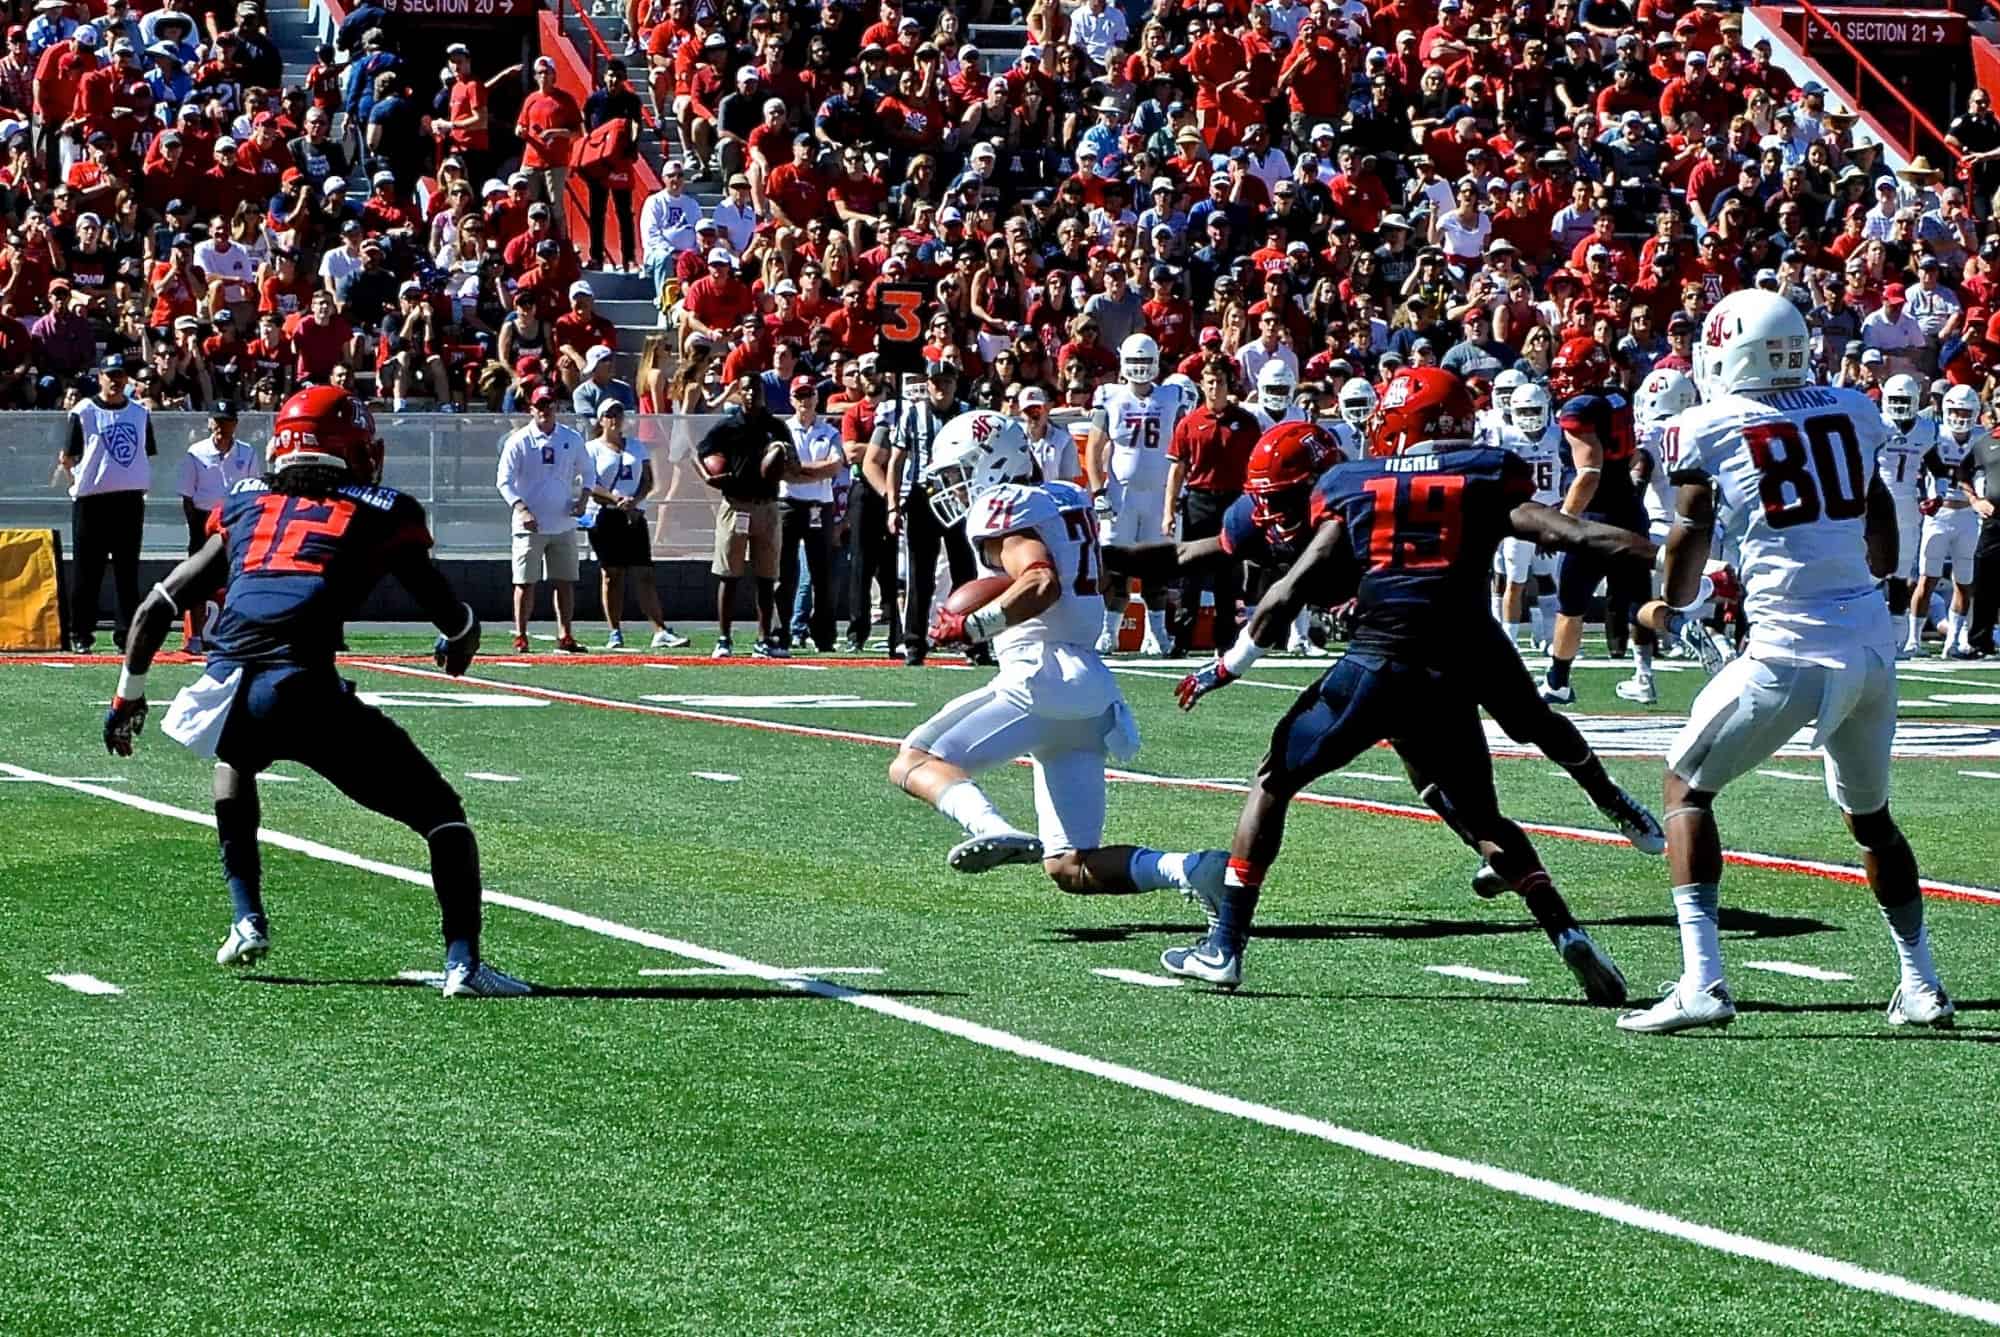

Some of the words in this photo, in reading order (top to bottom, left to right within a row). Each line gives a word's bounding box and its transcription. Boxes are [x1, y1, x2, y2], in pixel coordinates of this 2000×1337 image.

[403, 0, 468, 13] SECTION
[475, 0, 494, 14] 20
[1847, 22, 1906, 41] SECTION
[1912, 24, 1927, 42] 21
[881, 290, 923, 342] 3
[1124, 417, 1161, 449] 76
[1741, 413, 1866, 530] 80
[243, 494, 356, 574] 12
[984, 497, 1014, 530] 21
[1363, 475, 1466, 573] 19
